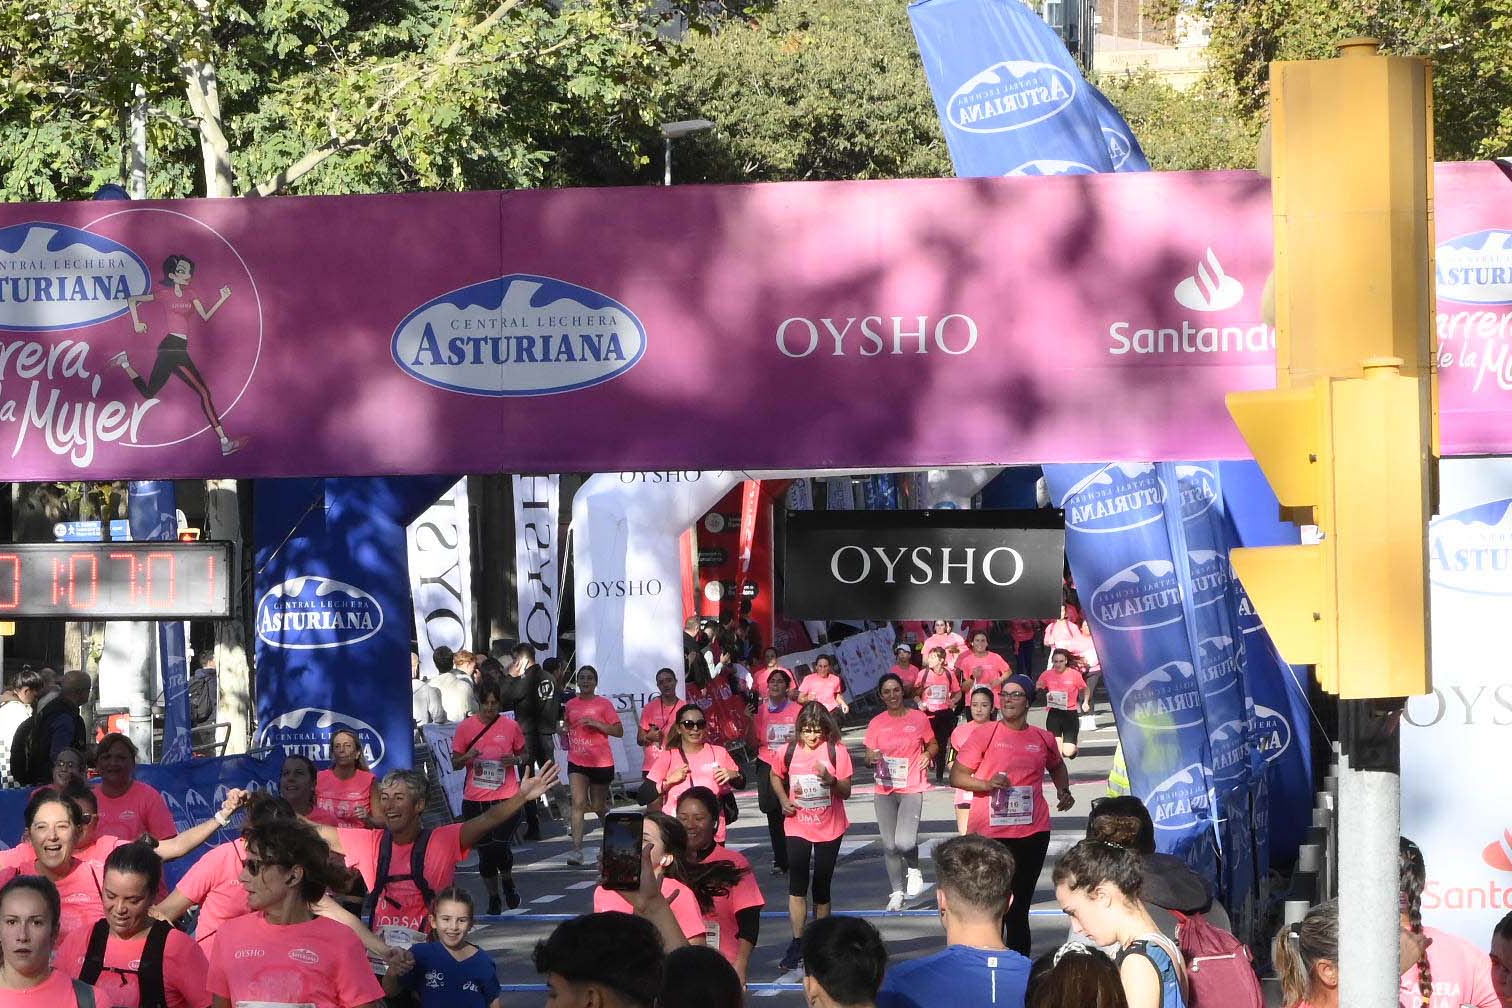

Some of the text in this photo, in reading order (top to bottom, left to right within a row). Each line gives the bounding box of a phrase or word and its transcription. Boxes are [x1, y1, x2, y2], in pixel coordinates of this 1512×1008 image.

[54, 257, 127, 270] LECHERA
[450, 313, 618, 331] CENTRAL LECHERA
[774, 312, 978, 359] OYSHO
[410, 321, 626, 367] ASTURIANA
[12, 374, 161, 468] Mujer
[830, 544, 1025, 587] OYSHO
[586, 578, 663, 600] OYSHO
[319, 599, 370, 609] LECHERA
[260, 605, 375, 634] ASTURIANA
